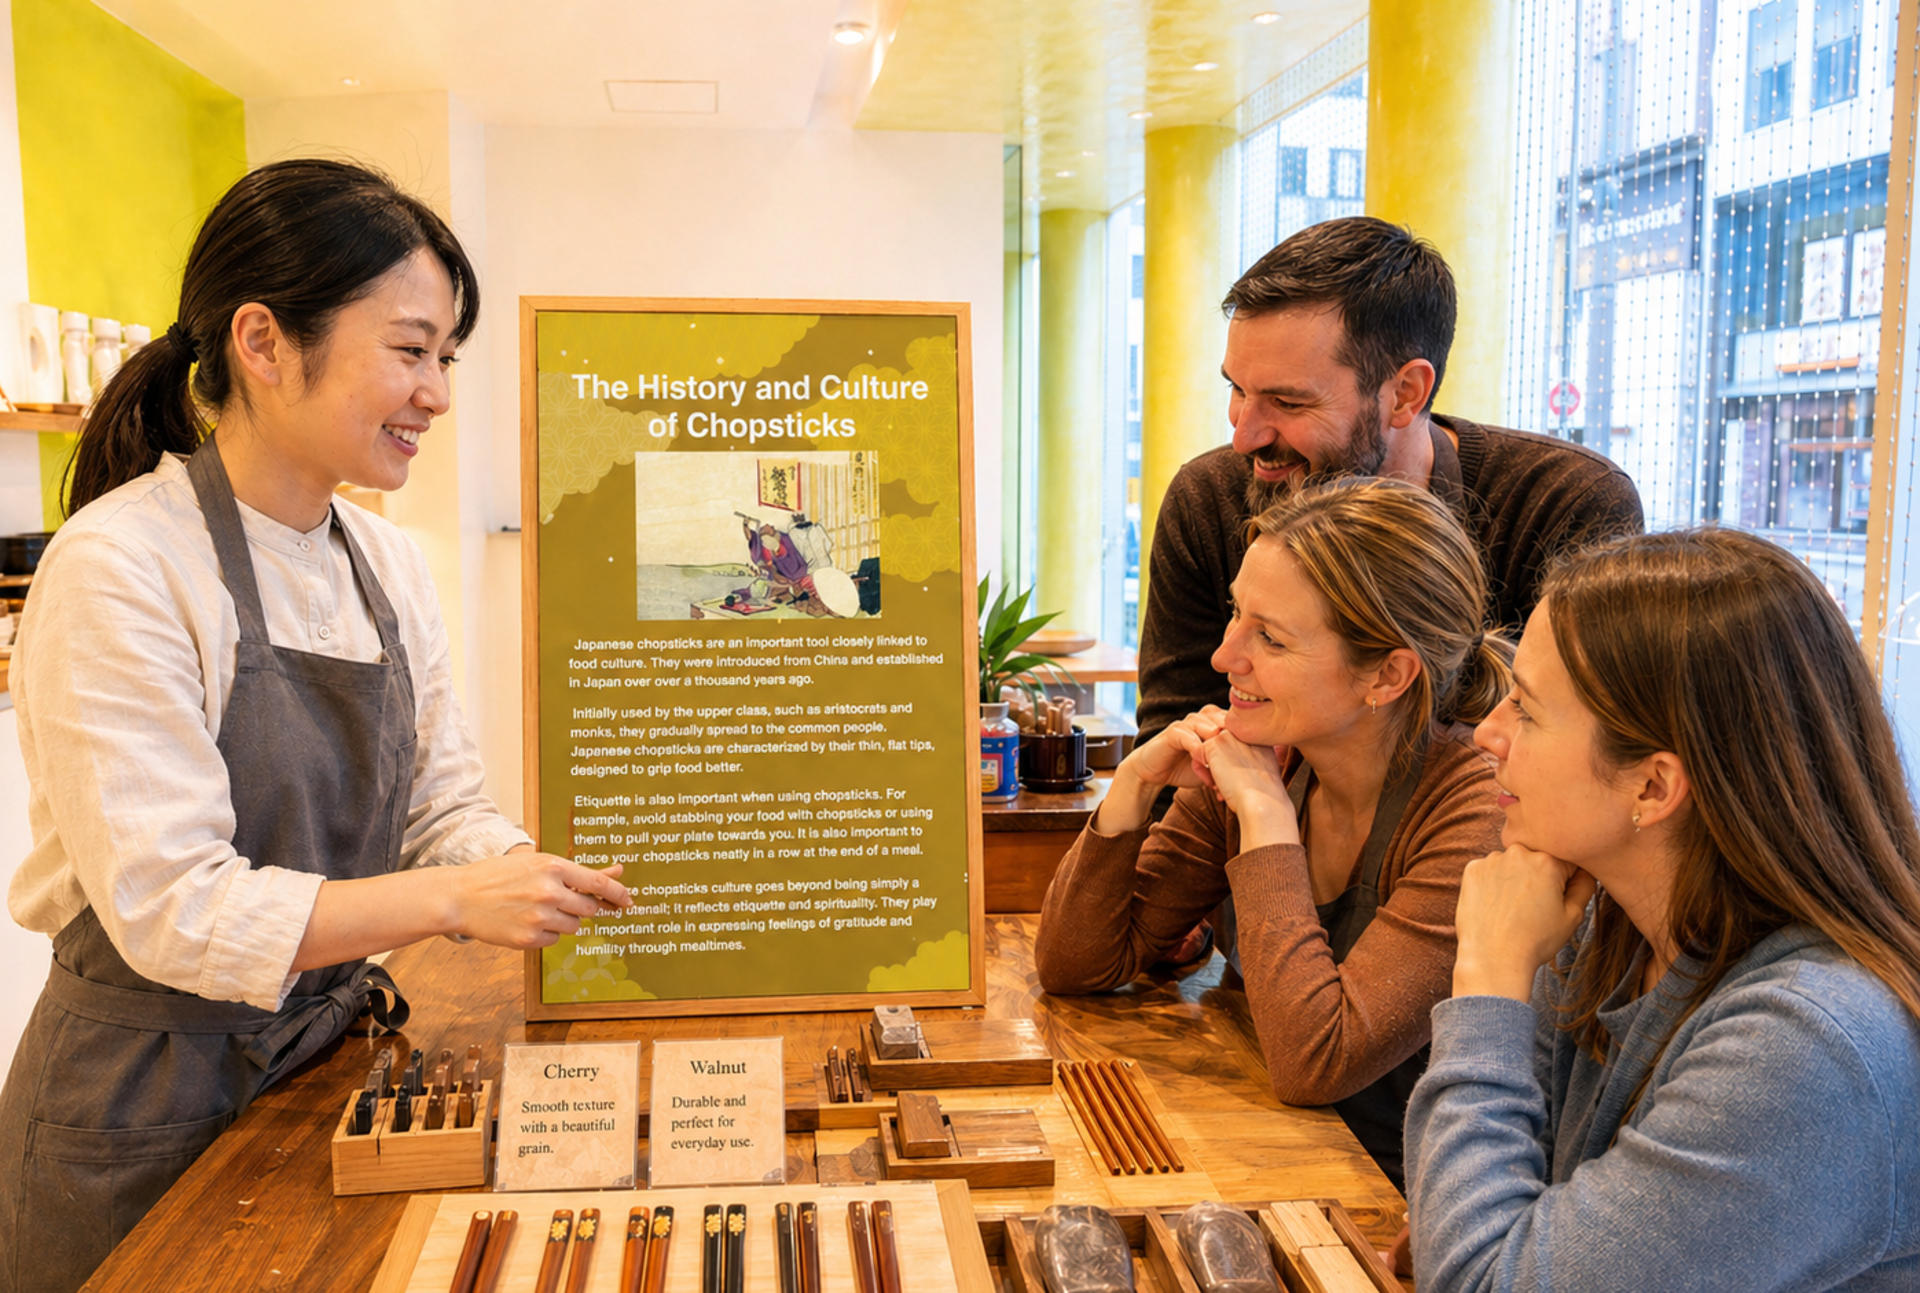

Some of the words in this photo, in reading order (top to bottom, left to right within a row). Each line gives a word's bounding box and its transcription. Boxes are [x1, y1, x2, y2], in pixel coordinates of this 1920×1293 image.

[571, 374, 628, 400] The
[639, 375, 746, 407] History
[756, 375, 809, 400] and
[820, 375, 928, 400] Culture
[648, 412, 678, 438] of
[687, 412, 856, 444] Chopsticks
[573, 639, 635, 653] Japanese
[636, 637, 704, 652] chopsticks
[705, 638, 726, 649] are
[727, 638, 744, 649] an
[745, 636, 804, 650] important
[805, 635, 830, 648] tool
[831, 635, 875, 650] closely
[876, 634, 913, 647] linked
[914, 635, 928, 647] to
[568, 657, 598, 670] food
[600, 657, 647, 670] culture.
[650, 656, 681, 671] They
[683, 658, 714, 668] were
[716, 655, 781, 668] introduced
[783, 655, 812, 667] from
[813, 653, 849, 666] China
[850, 654, 874, 666] and
[875, 652, 944, 666] established
[568, 676, 581, 688] in
[583, 676, 622, 690] Japan
[623, 677, 652, 687] over
[654, 677, 682, 687] over
[683, 676, 692, 687] a
[694, 673, 751, 687] thousand
[753, 675, 786, 688] years
[787, 675, 814, 688] ago.
[572, 706, 618, 721] Initially
[620, 706, 652, 719] used
[654, 705, 671, 721] by
[672, 705, 694, 718] the
[696, 706, 734, 720] upper
[735, 703, 772, 717] class,
[774, 704, 804, 716] such
[806, 705, 821, 715] as
[823, 703, 888, 715] aristocrats
[889, 702, 913, 714] and
[570, 726, 616, 739] monks,
[618, 724, 646, 740] they
[648, 723, 705, 740] gradually
[706, 723, 749, 738] spread
[750, 724, 764, 736] to
[765, 722, 786, 734] the
[787, 724, 841, 734] common
[842, 720, 887, 735] people.
[570, 745, 632, 760] Japanese
[633, 742, 702, 758] chopsticks
[703, 744, 725, 755] are
[726, 741, 809, 755] characterized
[810, 740, 826, 754] by
[828, 740, 857, 752] their
[857, 740, 885, 752] thin,
[887, 738, 907, 751] flat
[909, 739, 935, 753] tips,
[570, 763, 629, 778] designed
[631, 763, 645, 775] to
[647, 762, 672, 777] grip
[674, 761, 703, 774] food
[705, 761, 744, 773] better.
[574, 794, 632, 809] Etiquette
[634, 793, 646, 806] is
[648, 793, 676, 806] also
[677, 791, 738, 806] important
[740, 790, 775, 803] when
[777, 789, 812, 804] using
[813, 788, 883, 803] chopsticks.
[885, 787, 907, 800] For
[572, 813, 630, 829] example,
[632, 811, 667, 825] avoid
[669, 811, 724, 825] stabbing
[726, 811, 755, 825] your
[756, 809, 785, 822] food
[787, 808, 814, 821] with
[815, 807, 883, 823] chopsticks
[884, 808, 898, 818] or
[900, 807, 934, 822] using
[573, 833, 607, 846] them
[609, 832, 623, 845] to
[625, 831, 650, 847] pull
[652, 832, 682, 846] your
[683, 830, 715, 845] plate
[717, 828, 767, 842] towards
[768, 829, 795, 843] you.
[797, 826, 806, 839] It
[808, 826, 820, 839] is
[821, 827, 849, 839] also
[850, 826, 909, 840] important
[910, 826, 923, 837] to
[574, 852, 609, 865] place
[611, 852, 640, 866] your
[642, 849, 711, 865] chopsticks
[712, 848, 750, 863] neatly
[752, 847, 765, 859] in
[767, 849, 775, 859] a
[777, 848, 801, 859] row
[803, 847, 816, 858] at
[818, 846, 838, 858] the
[839, 844, 864, 857] end
[865, 843, 879, 857] of
[881, 846, 889, 857] a
[891, 843, 924, 856] meal.
[641, 882, 709, 898] chopsticks
[711, 881, 753, 894] culture
[755, 882, 785, 896] goes
[787, 879, 832, 894] beyond
[833, 878, 868, 892] being
[870, 876, 910, 891] simply
[911, 879, 920, 889] a
[673, 903, 682, 914] it
[684, 901, 731, 914] reflects
[732, 899, 786, 914] etiquette
[788, 898, 812, 911] and
[880, 895, 910, 911] They
[912, 895, 938, 910] play
[594, 922, 655, 937] important
[657, 921, 682, 934] role
[684, 920, 697, 932] in
[698, 919, 766, 934] expressing
[768, 917, 816, 932] feelings
[818, 915, 831, 929] of
[833, 915, 888, 931] gratitude
[889, 914, 913, 927] and
[628, 940, 678, 956] through
[679, 939, 746, 953] mealtimes.
[544, 1064, 599, 1081] Cherry
[691, 1060, 746, 1074] Walnut
[522, 1100, 569, 1113] Smooth
[573, 1101, 615, 1111] texture
[672, 1096, 720, 1108] Durable
[724, 1095, 746, 1106] and
[521, 1121, 547, 1133] with
[551, 1124, 558, 1132] a
[562, 1118, 614, 1132] beautiful
[672, 1116, 713, 1132] perfect
[718, 1115, 735, 1127] for
[518, 1143, 553, 1158] grain.
[671, 1136, 726, 1151] everyday
[730, 1139, 754, 1147] use.
